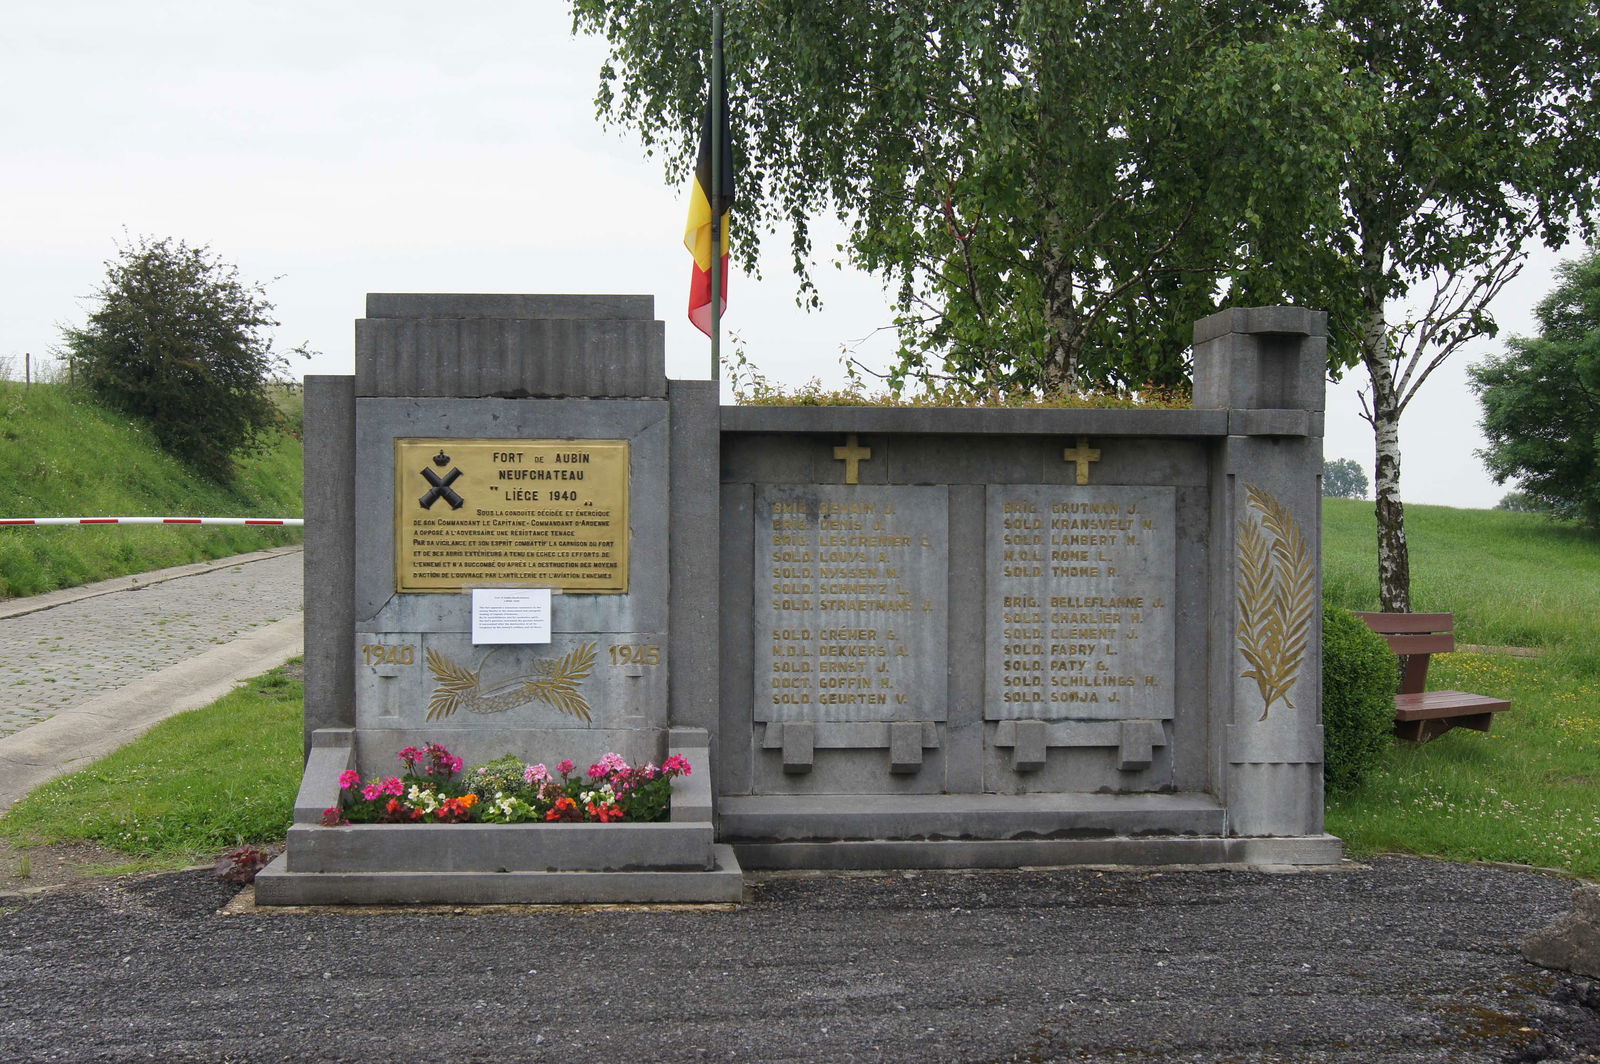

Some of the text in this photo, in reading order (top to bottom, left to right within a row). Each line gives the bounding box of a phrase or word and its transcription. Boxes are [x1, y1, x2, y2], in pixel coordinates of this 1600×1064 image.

[493, 453, 523, 463] FORT
[555, 451, 590, 463] AUBIN
[499, 470, 583, 480] NEUFCHATEAU
[549, 491, 576, 500] 1940
[820, 517, 864, 530] DENIS
[1004, 519, 1043, 529] SOLD.
[1051, 519, 1133, 530] KRANSVELT
[1004, 535, 1043, 545] SOLD.
[1051, 535, 1117, 545] LAMBERT
[772, 552, 813, 562] SOLD.
[1052, 551, 1088, 561] ROME
[773, 568, 814, 578] SOLD.
[1004, 567, 1043, 577] SOLD.
[772, 584, 813, 594] SOLD.
[773, 600, 813, 610] SOLD.
[1004, 594, 1040, 608] BRIG.
[1004, 613, 1044, 624] SOLD.
[1051, 610, 1121, 624] CHARLIER
[773, 630, 813, 640] SOLD.
[1004, 629, 1044, 639] SOLD.
[609, 644, 662, 666] 1945
[820, 646, 886, 656] DEKKERS
[1004, 645, 1117, 655] SOLD. FABRY L.
[362, 645, 414, 666] 1940
[773, 662, 889, 672] SOLD. ERNST J.
[1004, 661, 1109, 671] SOLD. PATY G.
[820, 675, 871, 688] GOFFIN
[1004, 676, 1044, 686] SOLD.
[1051, 673, 1136, 686] SCHILLINGS
[773, 694, 812, 704] SOLD.
[1004, 692, 1044, 702] SOLD.
